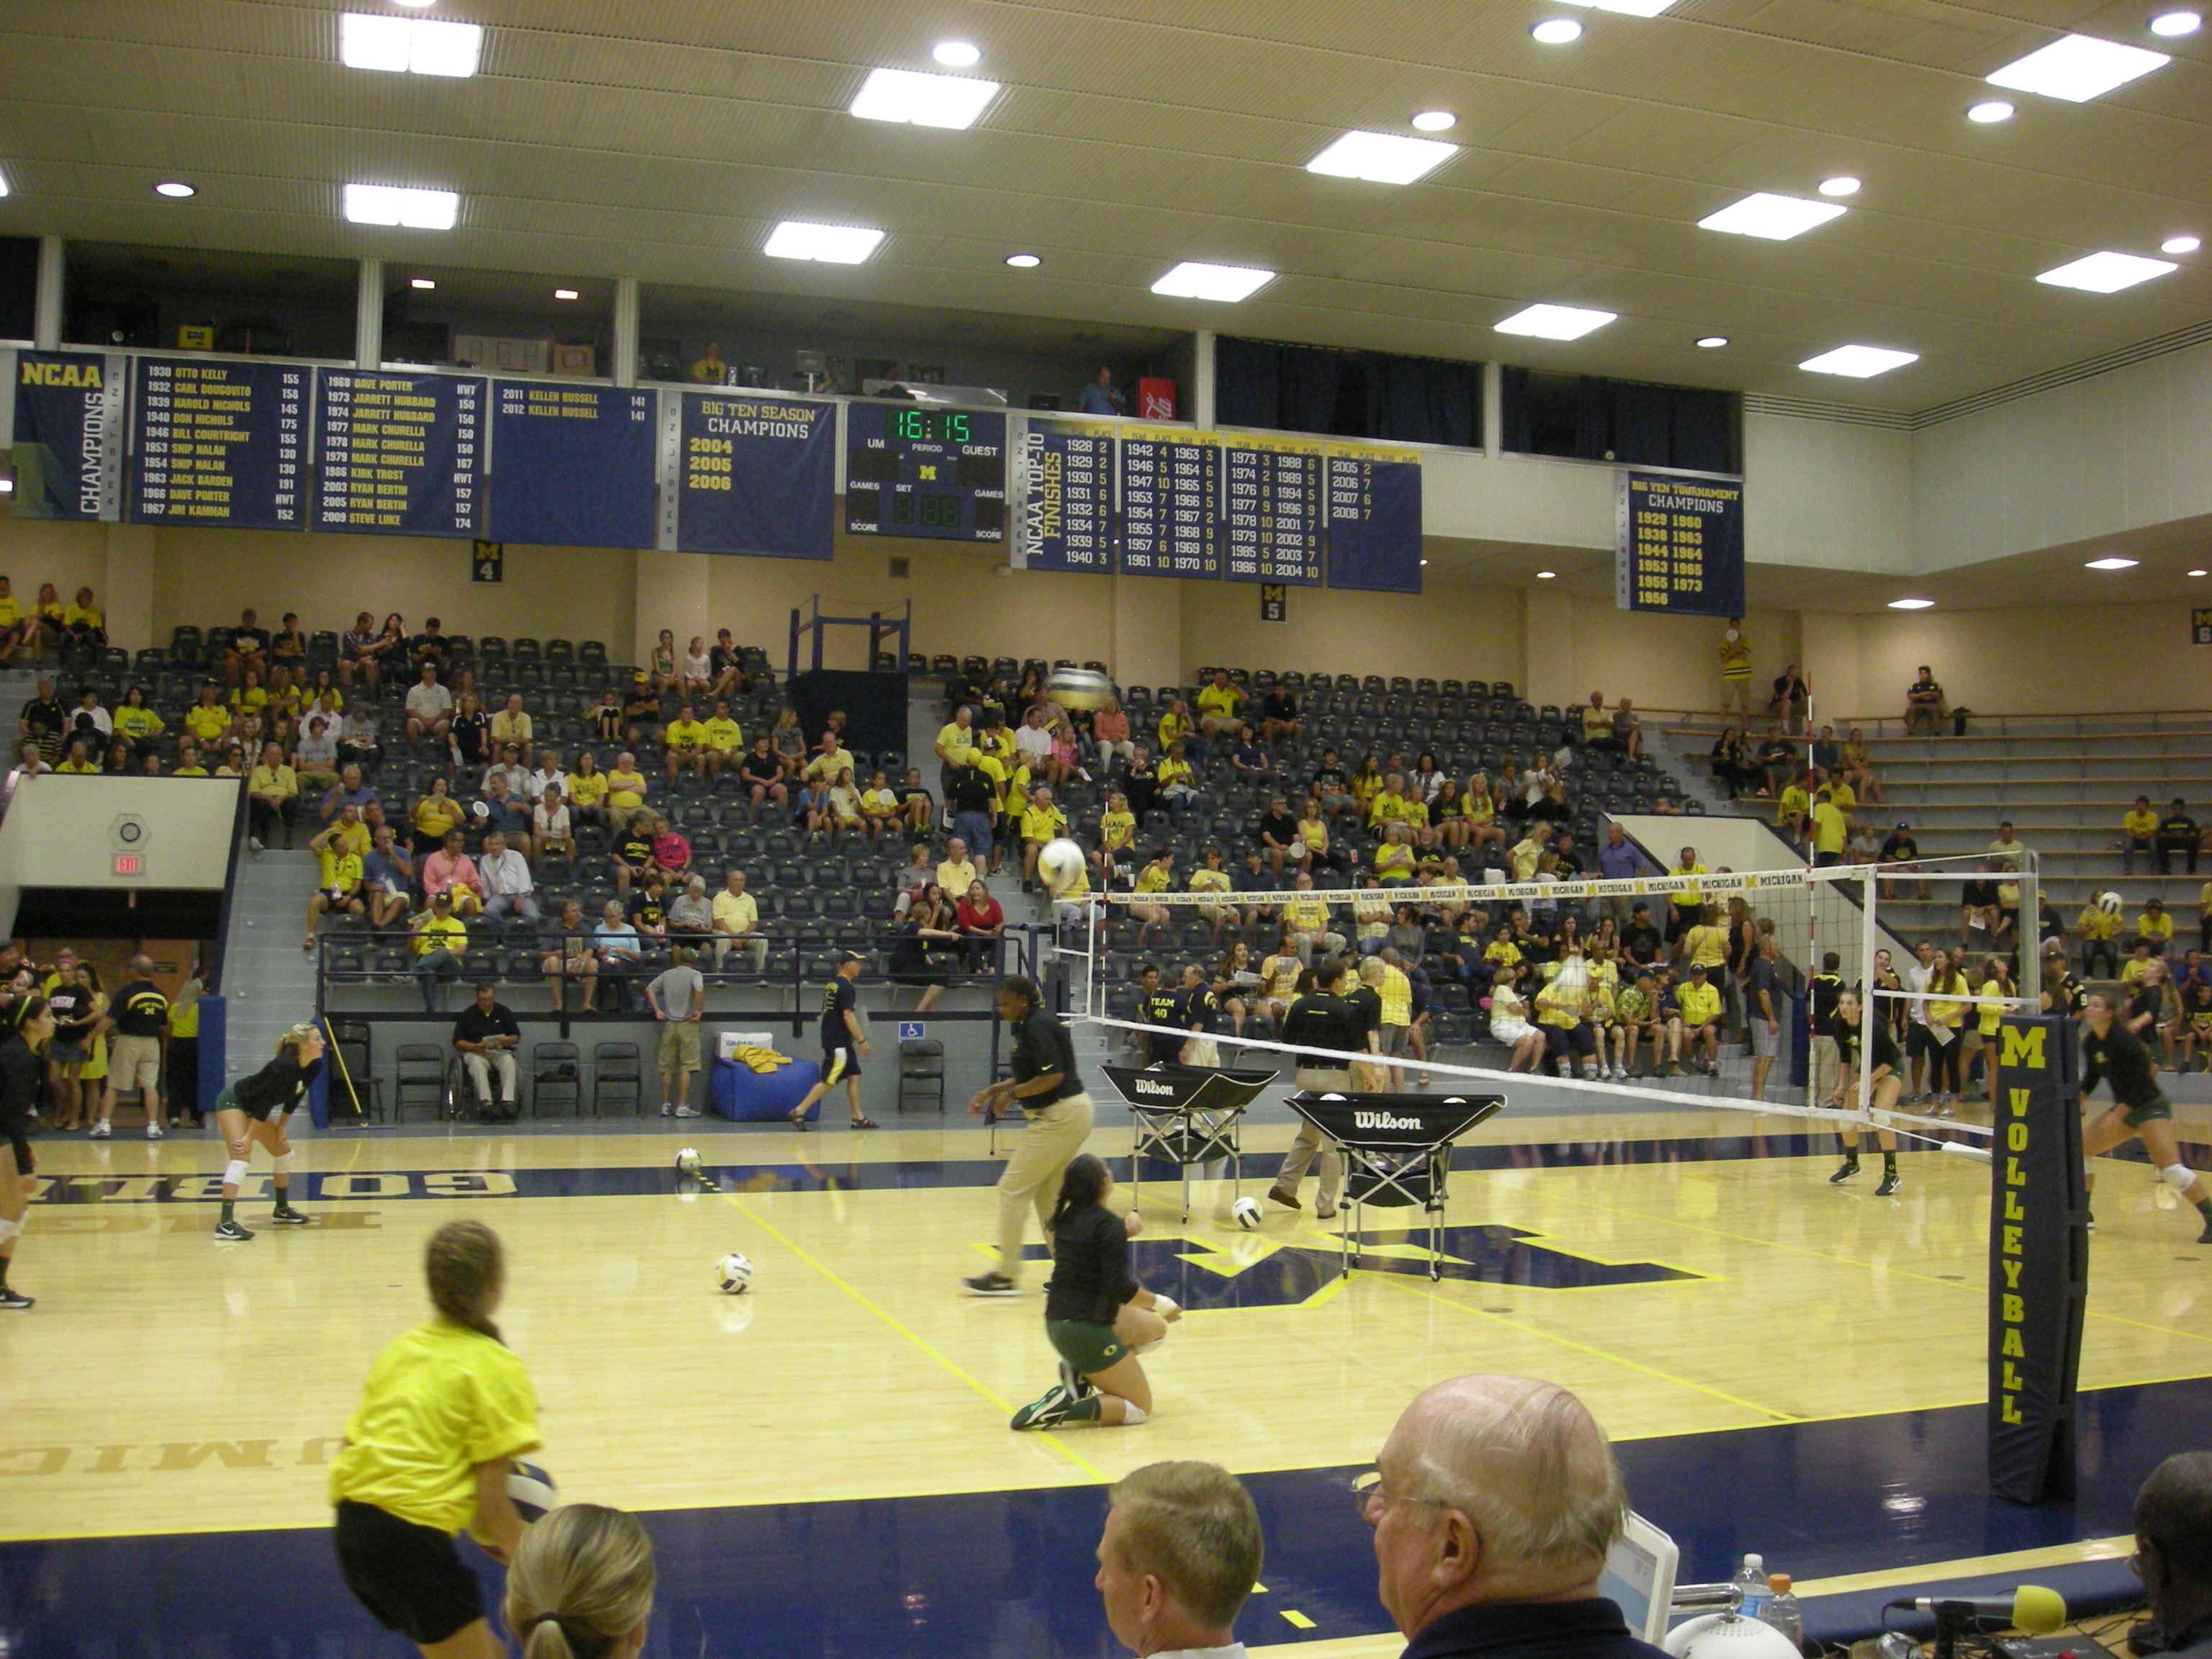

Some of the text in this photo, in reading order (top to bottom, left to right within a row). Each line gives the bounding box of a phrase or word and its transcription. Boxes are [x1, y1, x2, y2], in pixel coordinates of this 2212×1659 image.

[22, 362, 102, 388] NCAA
[148, 366, 299, 385] 1930 OTTO KELLY 155
[148, 381, 171, 392] 1932
[174, 382, 197, 394] CARL
[282, 389, 298, 399] 158
[329, 376, 476, 395] 1968 DAVE PORTER HWT
[148, 396, 297, 414] 1939 HAROLD NICHOLS 145
[328, 392, 475, 410] 1973 JARRETT HUBBARD 150
[503, 389, 644, 406] 2011 KELLEN RUSSELL 141
[147, 411, 297, 429] 1940 DON NICHOLS 175
[328, 406, 474, 425] 1974 JARRETT HUBBARD 150
[503, 404, 644, 421] 2012 KELLEN RUSSELL 141
[702, 401, 815, 422] BIG TEN SEASON
[709, 418, 809, 439] CHAMPIONS
[899, 411, 969, 442] 16:15
[81, 392, 105, 513] CHAMPIONS
[690, 438, 732, 454] 2004
[868, 439, 884, 449] UM
[912, 444, 943, 453] PERIOD
[962, 446, 997, 456] GUEST
[1066, 440, 1107, 453] 1928 2
[1128, 444, 1213, 461] 1942 4 1963 3
[689, 456, 732, 472] 2005
[1066, 455, 1107, 469] 1929 2
[1128, 460, 1213, 477] 1946 5 1964 6
[1333, 461, 1371, 475] 2005 2
[920, 465, 936, 480] M
[1066, 471, 1107, 485] 1930 5
[689, 475, 731, 490] 2006
[850, 481, 880, 490] GAMES
[1128, 475, 1213, 492] 1947 10 1965 5
[1333, 476, 1371, 490] 2006 7
[1632, 481, 1739, 500] BIG TEN TOURNAMENT
[975, 490, 1004, 498] GAMES
[1028, 433, 1044, 555] NCAA TOP-10
[1045, 452, 1061, 539] FINISHES
[1066, 487, 1107, 500] 1931 6
[1333, 492, 1371, 505] 2007 6
[143, 503, 165, 514] 1967
[168, 505, 185, 515] JIM
[278, 509, 294, 520] 152
[1066, 503, 1107, 516] 1932 6
[1649, 494, 1723, 513] CHAMPIONS
[323, 512, 471, 529] 2009 STEVE LUKE 174
[1333, 507, 1371, 520] 2008 7
[851, 523, 878, 531] SCORE
[1128, 554, 1216, 570] 1961 10 1970 10
[480, 562, 493, 580] 4
[1268, 603, 1280, 619] 5
[117, 857, 139, 872] EXIT
[1598, 883, 1632, 893] MICHIGAN
[1647, 881, 1686, 891] MICHIGAN
[1701, 878, 1742, 889] MICHIGAN
[1760, 873, 1803, 886] MICHIGAN
[1151, 997, 1175, 1007] TEAM
[1154, 1008, 1167, 1018] 40
[2000, 1025, 2046, 1069] M
[1135, 1079, 1174, 1096] Wilson
[1353, 1111, 1423, 1130] Wilson
[2001, 1088, 2031, 1425] VOLLEYBALL
